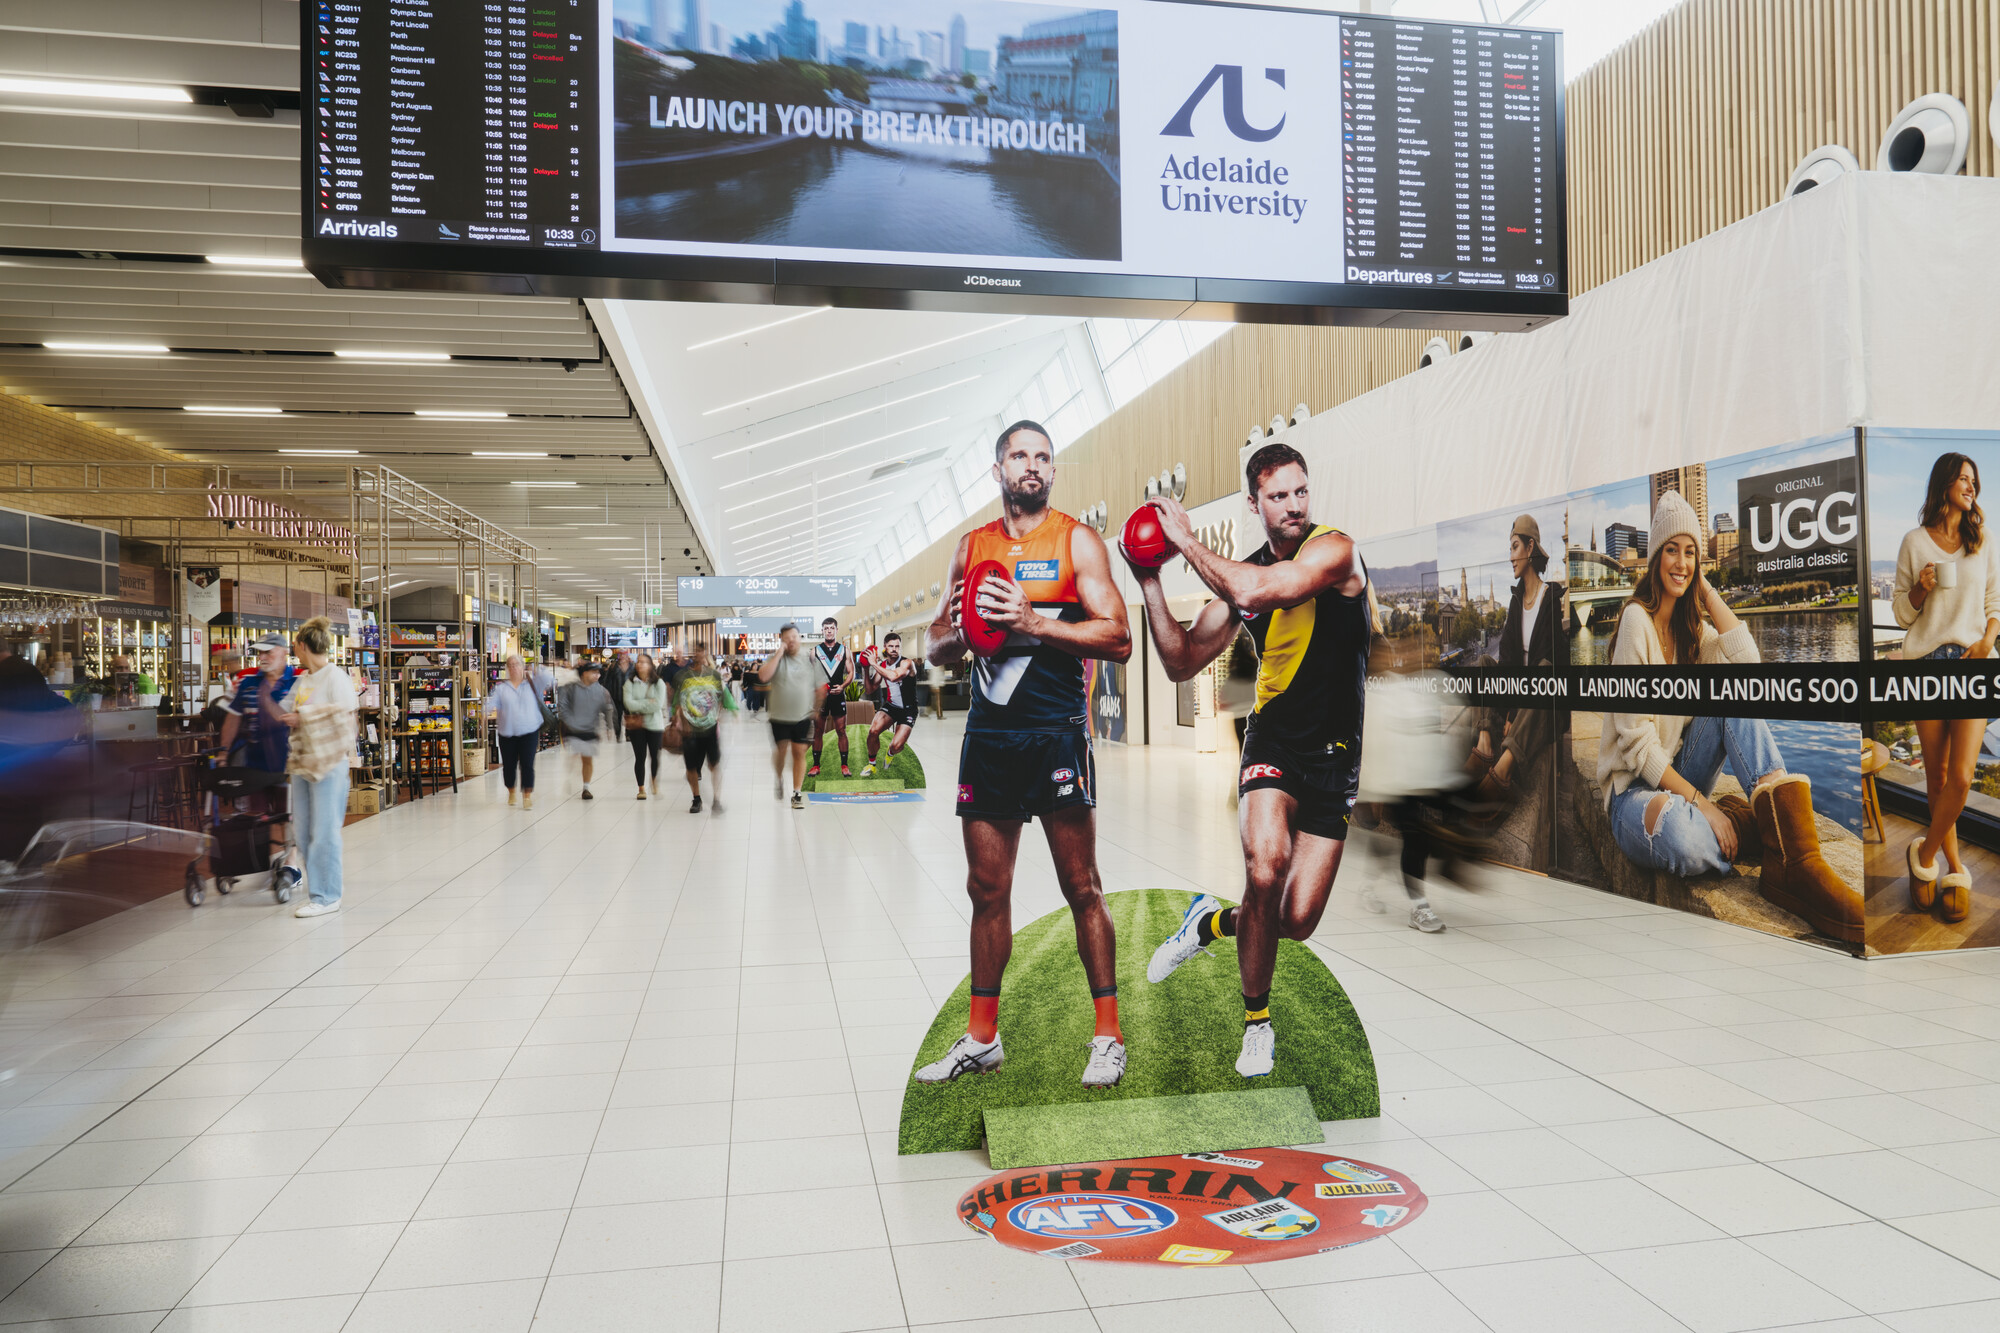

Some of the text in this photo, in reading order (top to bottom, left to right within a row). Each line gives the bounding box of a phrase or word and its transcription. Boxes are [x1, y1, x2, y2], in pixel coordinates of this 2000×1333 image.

[390, 9, 417, 17] Olympic
[418, 10, 433, 18] Dam
[390, 20, 404, 28] Port
[533, 31, 558, 39] Delayed
[390, 43, 564, 62] Melbourne Cancelled
[390, 55, 424, 64] Prominent
[390, 67, 420, 75] Canberra
[390, 78, 425, 87] Melbourne
[391, 90, 415, 99] Sydney
[406, 103, 432, 111] Augusta
[391, 113, 415, 122] Sydney
[533, 122, 558, 130] Delayed
[650, 95, 1086, 154] LAUNCH YOUR BREAKTHROUGH
[391, 125, 421, 133] Auckland
[391, 137, 415, 145] Sydney
[336, 145, 357, 153] VA219
[391, 148, 426, 157] Melbourne
[391, 160, 420, 168] Brisbane
[533, 168, 559, 176] Delayed
[1160, 153, 1289, 186] Adelaide
[391, 172, 418, 180] Olympic
[392, 183, 415, 192] Sydney
[392, 195, 420, 203] Brisbane
[1160, 184, 1308, 224] University
[320, 218, 398, 237] Arrivals
[468, 232, 494, 240] baggage
[544, 229, 574, 239] 10:33
[1348, 266, 1433, 284] Departures
[1515, 273, 1538, 283] 10:33
[964, 275, 1022, 288] JCDecaux
[1775, 476, 1824, 493] ORIGINAL
[1749, 491, 1858, 552] UGG
[1018, 563, 1048, 571] TOYO
[1756, 550, 1848, 572] australia classic
[1022, 570, 1056, 578] TIRES
[690, 579, 703, 590] 19
[745, 579, 778, 589] 20-50
[255, 592, 272, 606] WINE
[100, 605, 122, 614] DELICIOUS
[123, 608, 137, 616] TREATS
[137, 608, 142, 616] TO
[328, 603, 342, 615] PIRITS
[738, 638, 782, 650] Adelaid
[1442, 677, 1472, 694] SOON
[1477, 678, 1528, 696] LANDING
[1531, 677, 1568, 697] SOON
[1580, 678, 1648, 699] LANDING
[1651, 678, 1700, 700] SOON
[1710, 678, 1802, 703] LANDING
[1808, 678, 1858, 704] SOO
[1870, 675, 1986, 702] LANDING
[1054, 770, 1072, 780] AFL
[1241, 764, 1280, 785] KFC
[1218, 1156, 1258, 1166] SOUTH
[960, 1167, 1301, 1221] SHERRIN
[1320, 1182, 1396, 1196] ADELAIDE
[1150, 1194, 1208, 1204] KANGAROO
[1026, 1203, 1164, 1230] AFL
[1219, 1202, 1290, 1224] ADELAIDE
